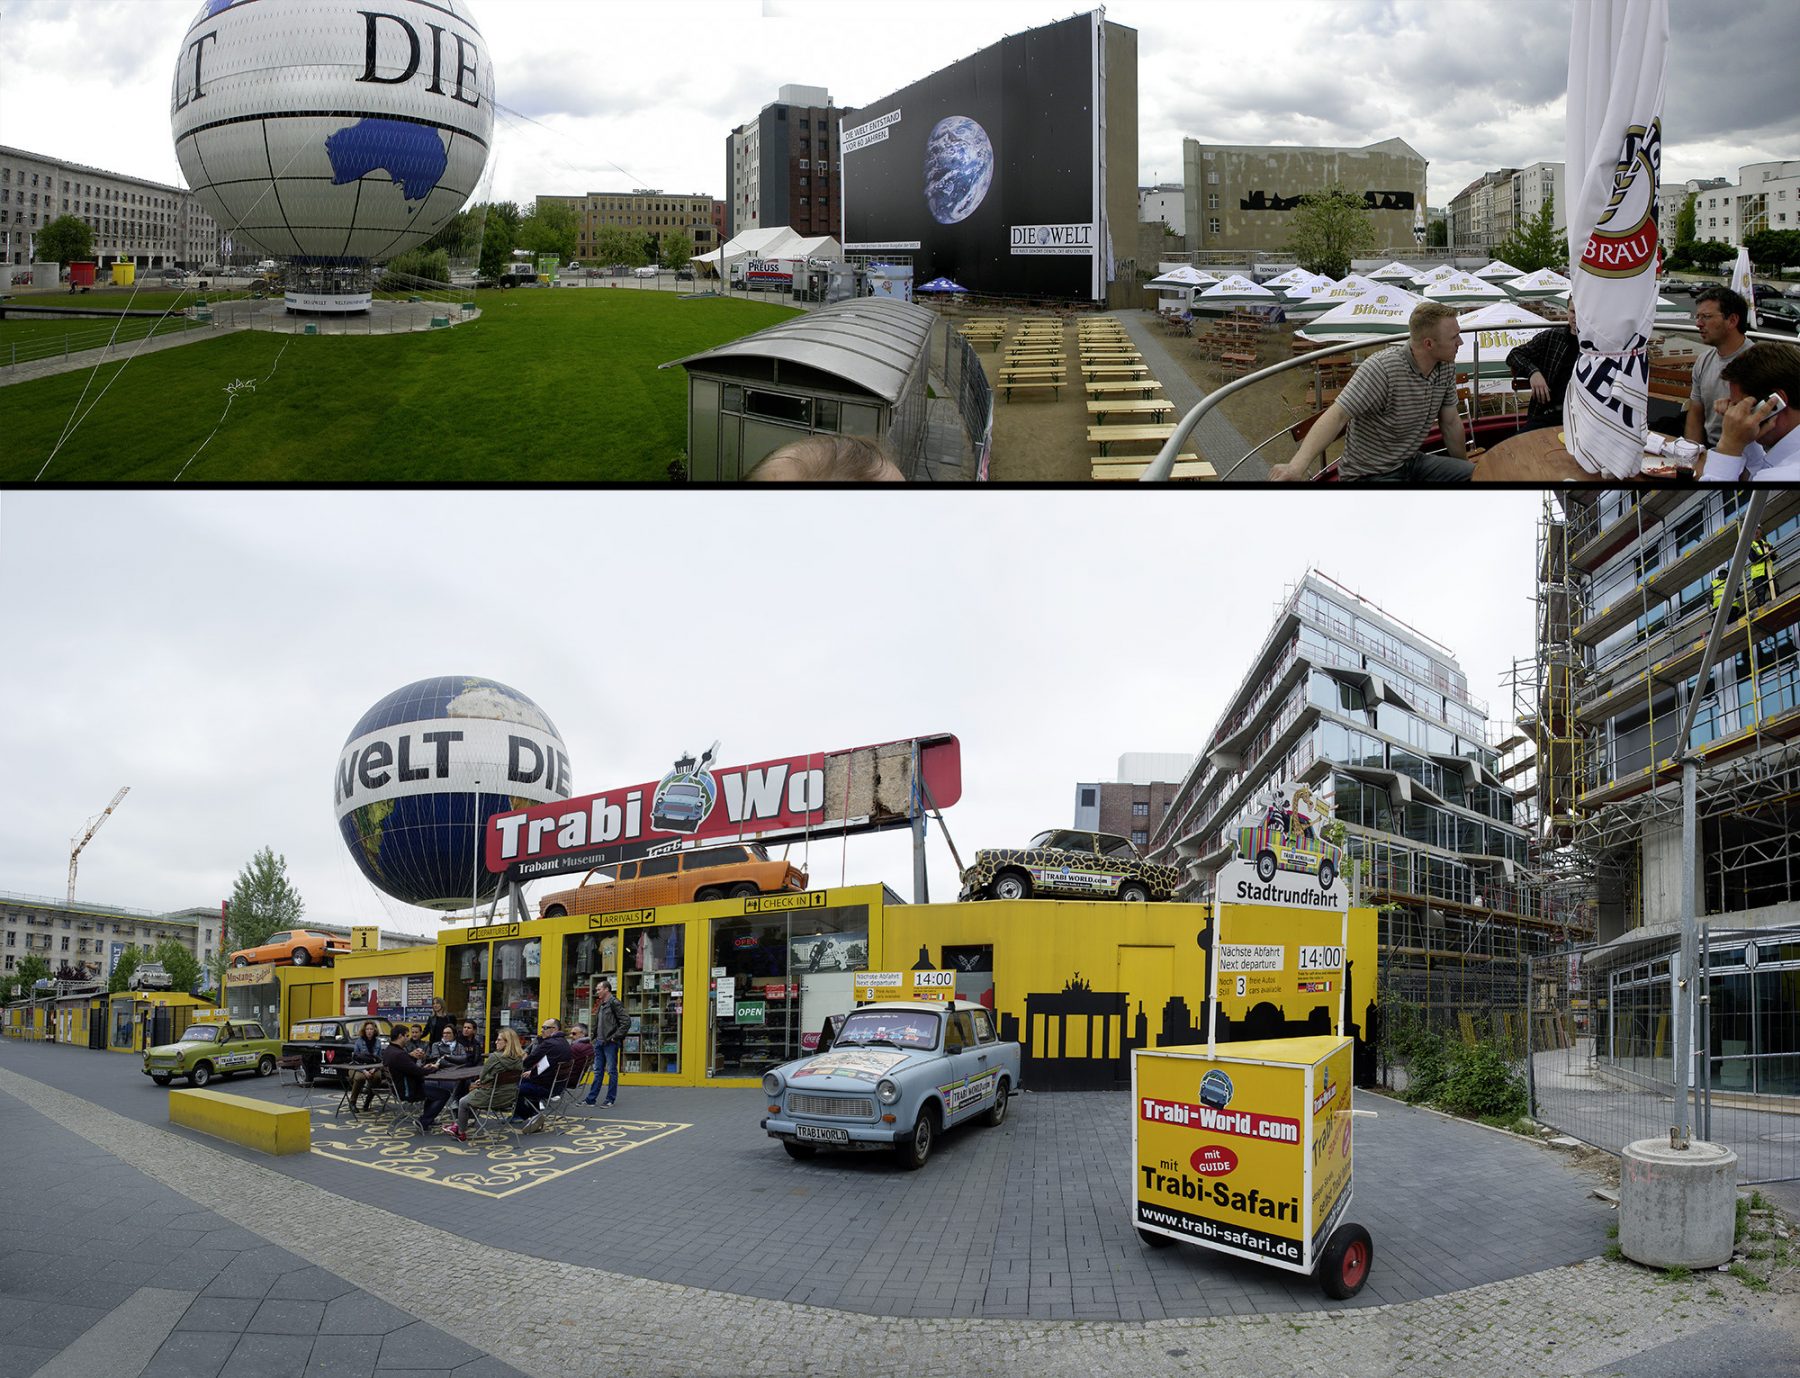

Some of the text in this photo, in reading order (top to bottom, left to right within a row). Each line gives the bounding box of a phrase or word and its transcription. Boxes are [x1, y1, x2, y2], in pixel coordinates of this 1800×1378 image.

[355, 10, 481, 108] DIE
[845, 112, 900, 140] DIE WELT ENTSTAND
[845, 142, 856, 151] VOR
[1012, 226, 1092, 244] DIE WELT
[1583, 235, 1649, 264] BRÄU
[748, 262, 779, 272] PREUSS
[1329, 289, 1366, 297] Bitburger
[1449, 284, 1484, 292] Bitburger
[1352, 304, 1404, 317] Bitburger
[508, 734, 570, 798] DIE
[496, 764, 824, 860] Trabi Wo
[518, 858, 560, 874] Trabant
[561, 852, 605, 868] Museum
[1069, 875, 1107, 884] WORLD.com
[1237, 881, 1338, 907] Stadtrundfahrt
[764, 897, 807, 908] CHECK IN
[603, 912, 640, 924] ARRIVALS
[478, 926, 509, 938] DEPARTURES
[735, 938, 758, 946] OPEN
[1221, 946, 1280, 957] Nächste Abfahrt
[1301, 948, 1340, 968] 14:00
[1220, 959, 1276, 970] Next departure
[916, 973, 952, 985] 14:00
[1237, 978, 1245, 995] 3
[868, 989, 873, 998] 3
[738, 1008, 762, 1017] OPEN
[321, 1050, 326, 1063] I
[954, 1090, 968, 1102] TRABI
[1143, 1100, 1297, 1142] Trabi-World.com
[798, 1127, 847, 1141] TRABIWORLD
[1312, 1108, 1333, 1167] Trabi
[1204, 1151, 1220, 1159] mit
[1160, 1159, 1178, 1172] mit
[1199, 1162, 1230, 1172] GUIDE
[1141, 1165, 1298, 1223] Trabi-Safari
[1141, 1208, 1298, 1258] www.trabi-safari.de
